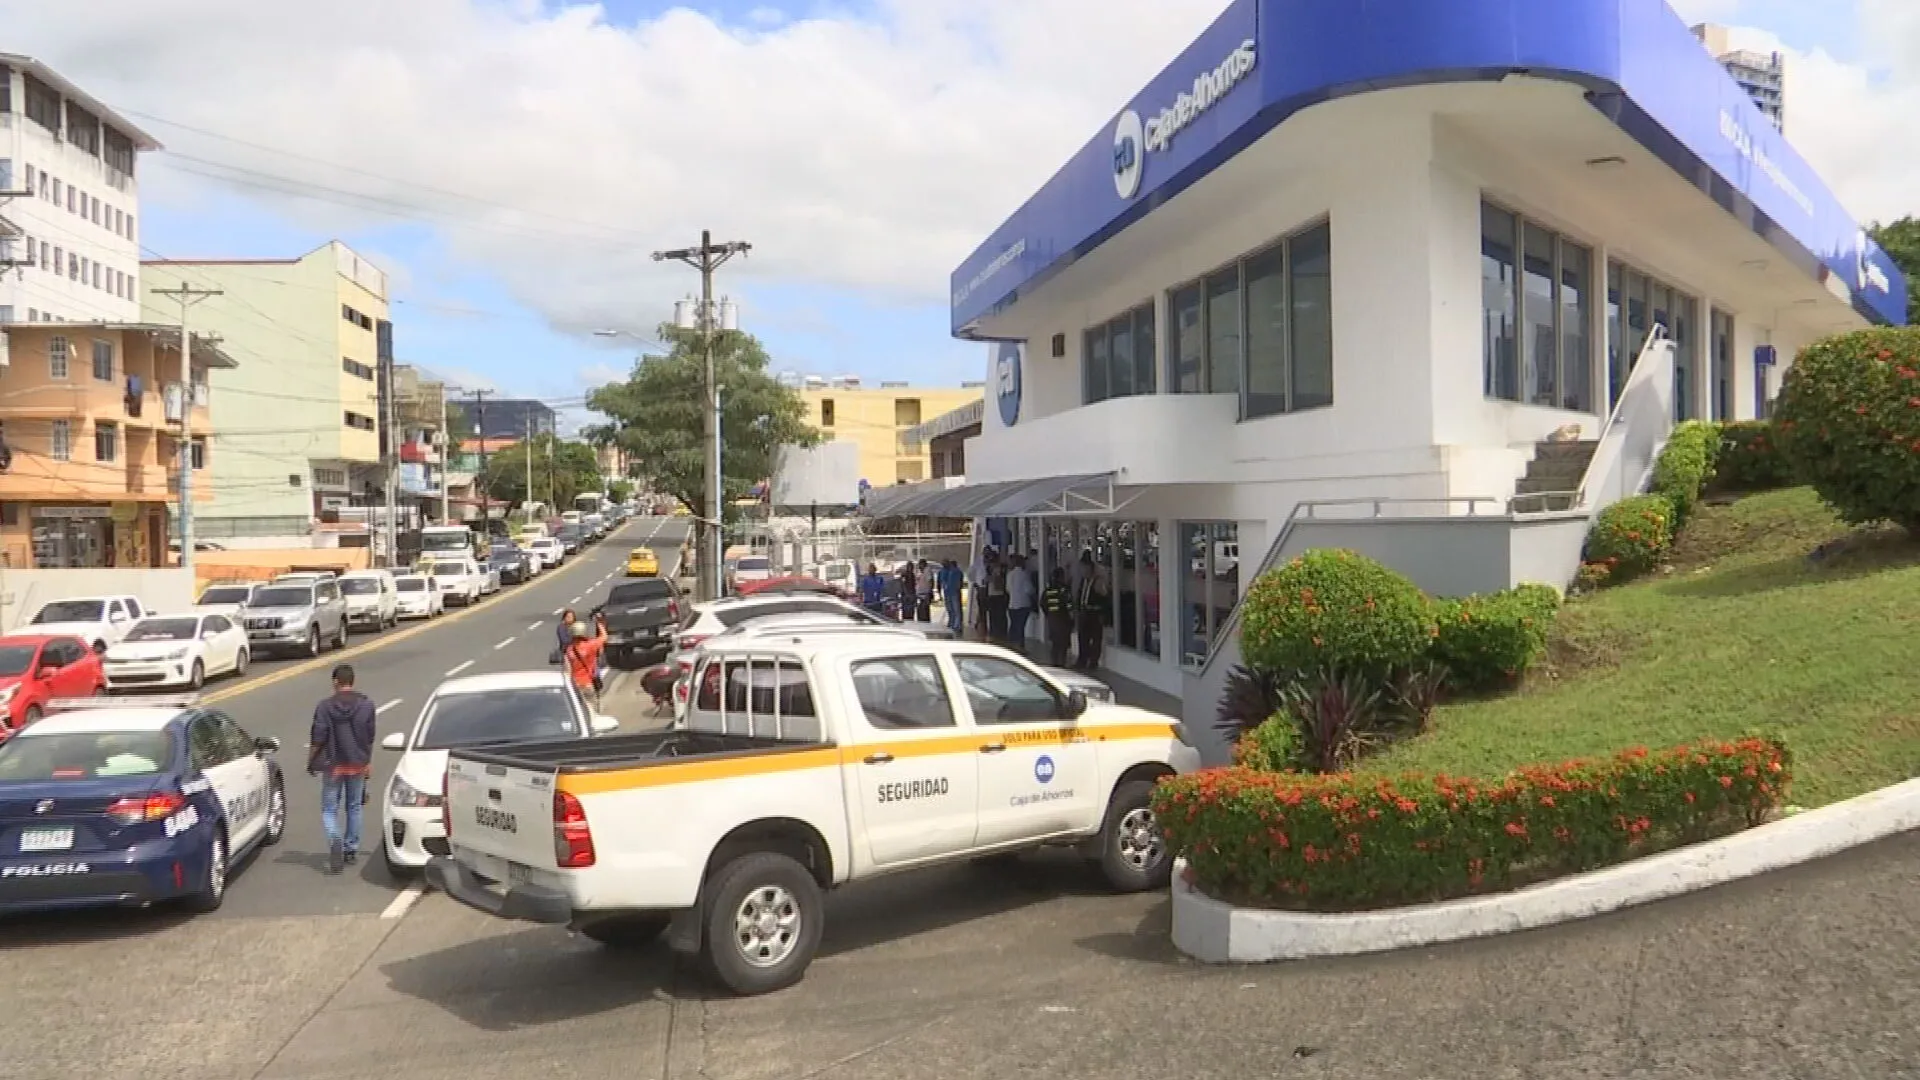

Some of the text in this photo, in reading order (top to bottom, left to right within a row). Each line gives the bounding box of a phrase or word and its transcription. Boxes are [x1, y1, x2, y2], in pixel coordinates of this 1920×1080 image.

[1191, 39, 1256, 118] Ahorros
[1023, 729, 1042, 742] PARA
[878, 777, 949, 804] SEGURIDAD
[1, 862, 90, 878] POLICIA
